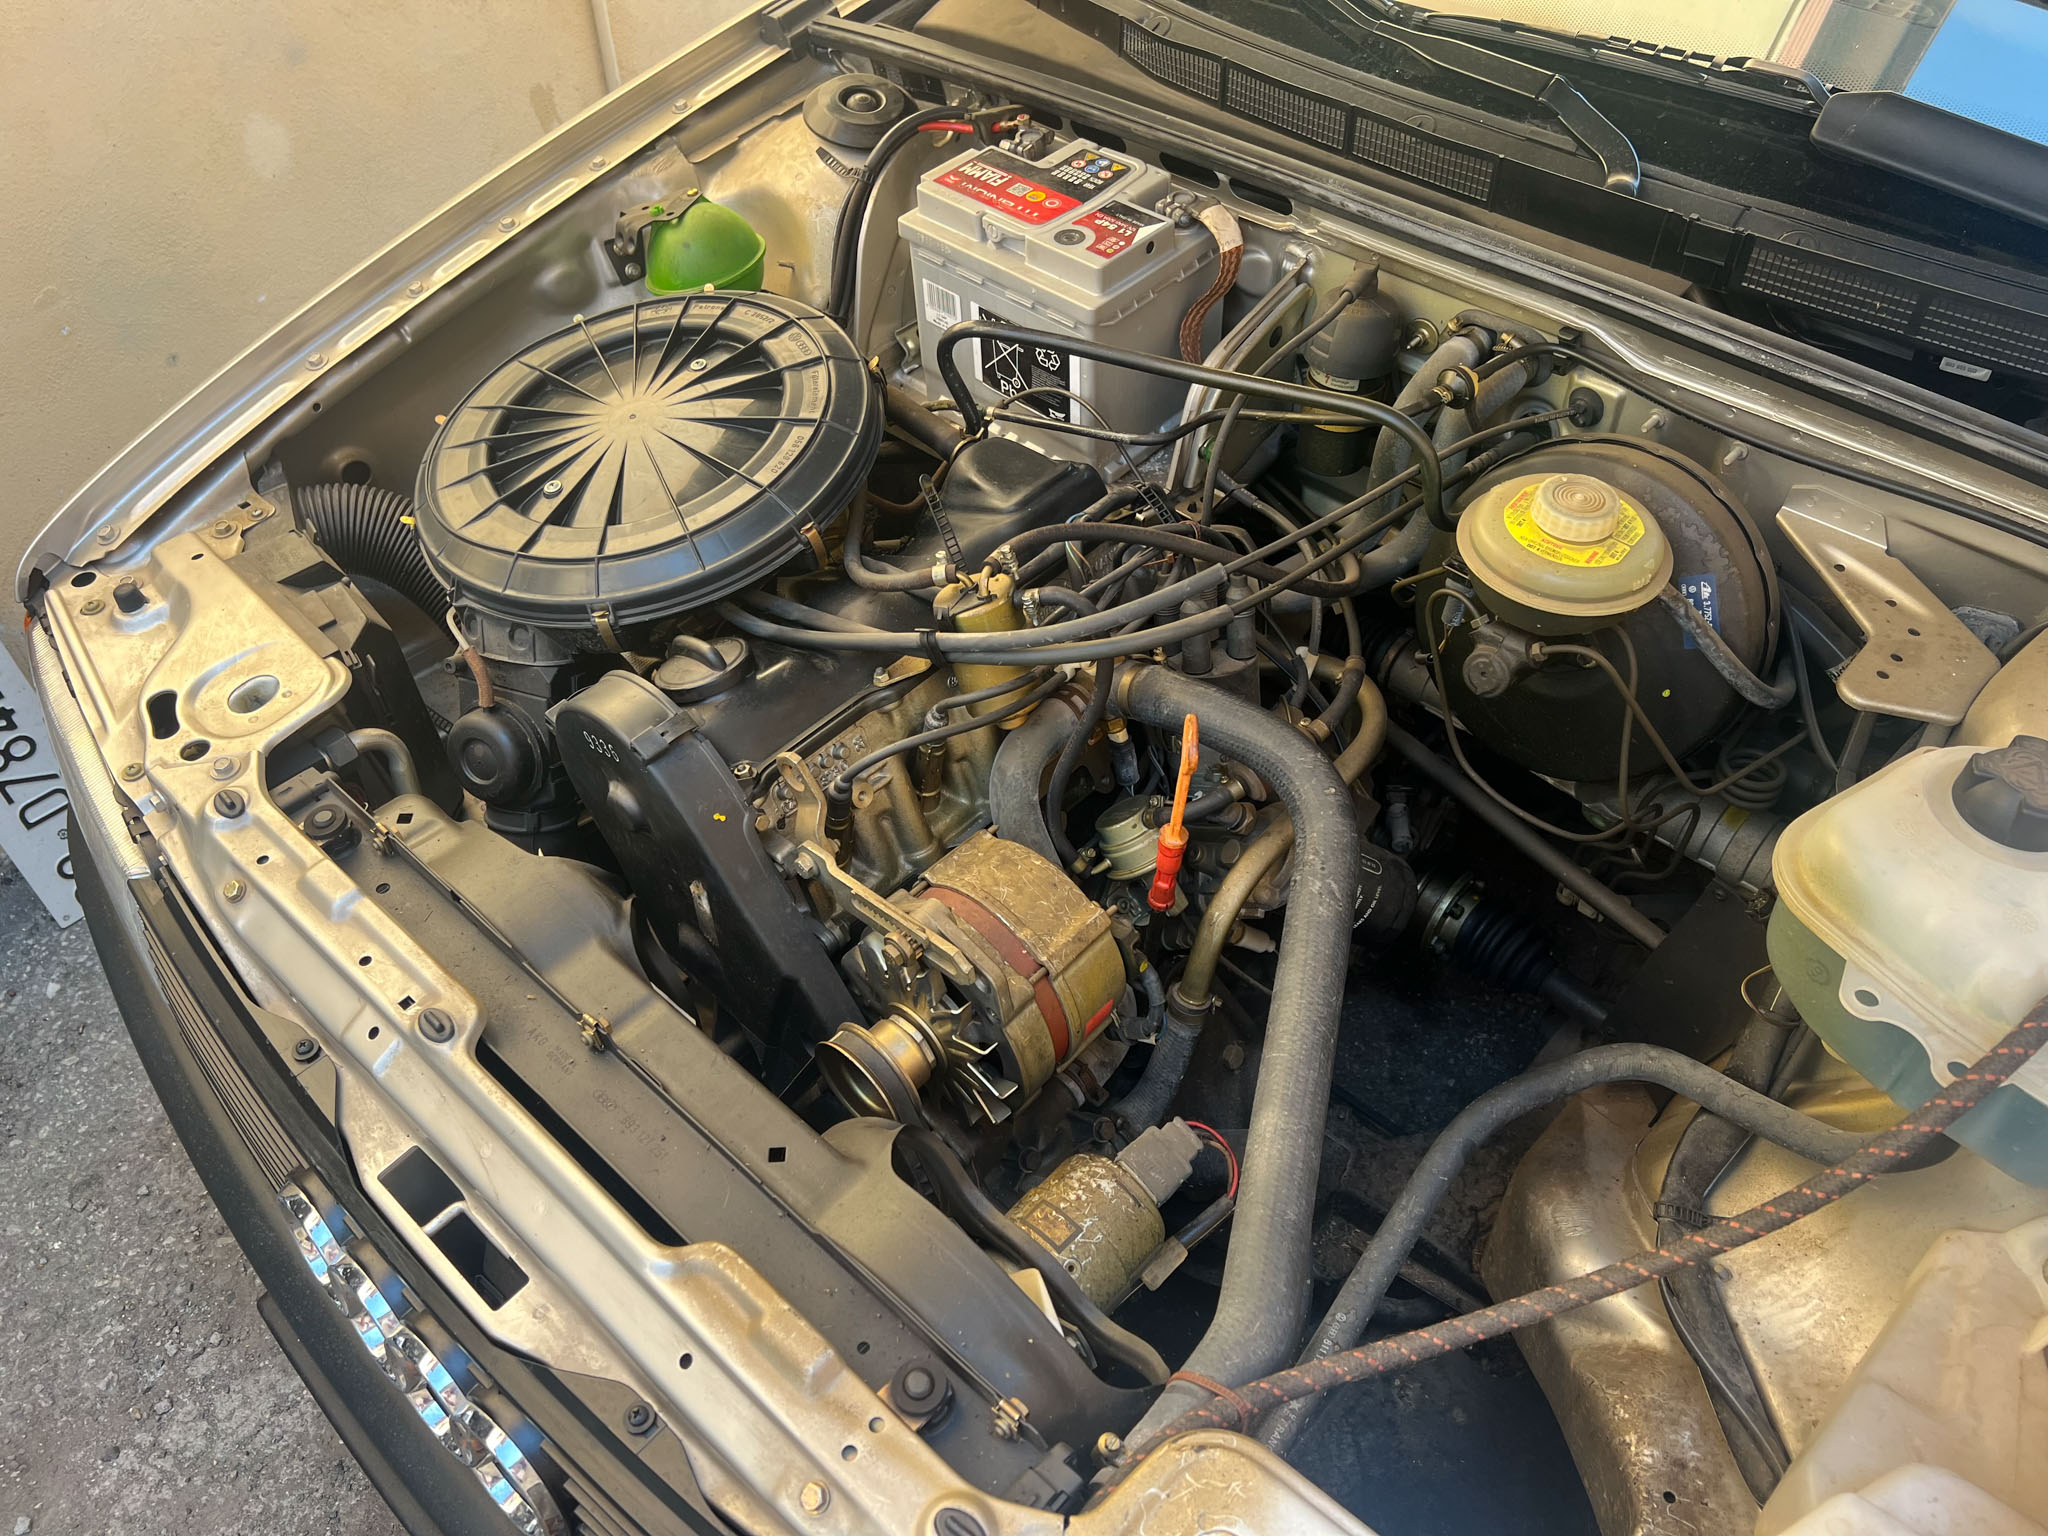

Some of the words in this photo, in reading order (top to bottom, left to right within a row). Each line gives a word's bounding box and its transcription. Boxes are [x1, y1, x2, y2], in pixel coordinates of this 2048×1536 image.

[958, 162, 1009, 187] FIAMM
[1000, 379, 1017, 398] Pb
[582, 730, 620, 763] 9336
